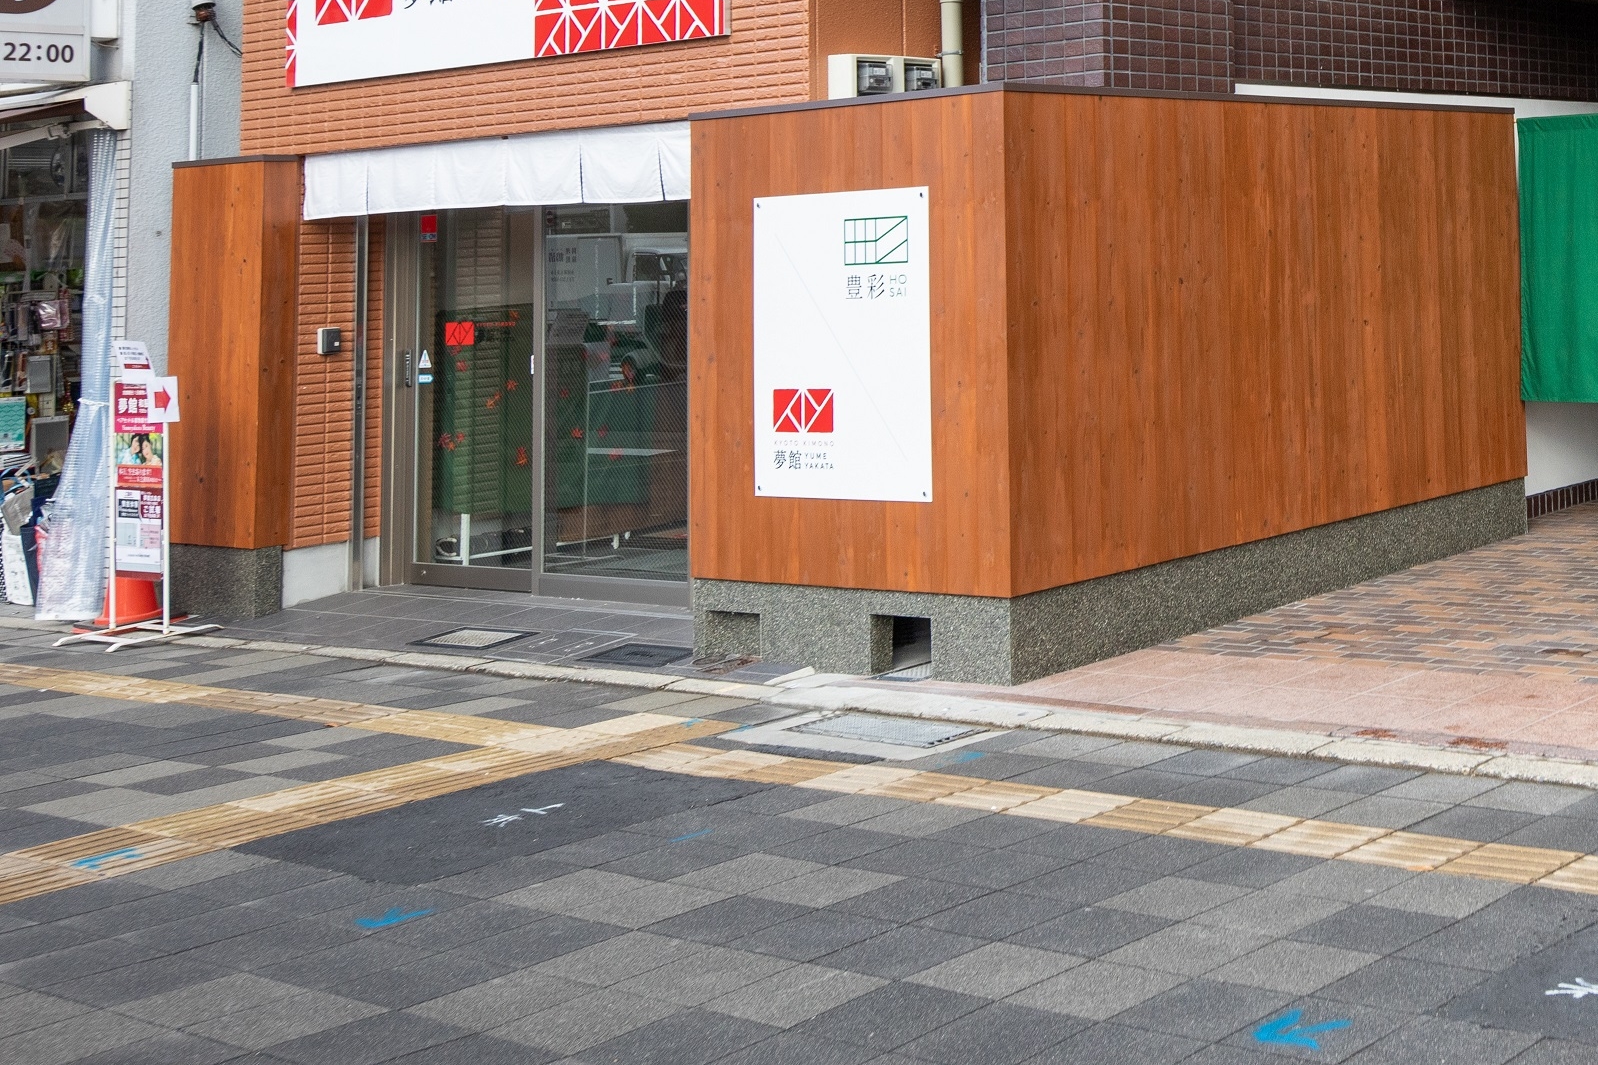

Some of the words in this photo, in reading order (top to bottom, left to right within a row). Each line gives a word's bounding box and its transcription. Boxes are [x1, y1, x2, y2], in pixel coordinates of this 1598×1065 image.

[3, 42, 74, 63] 22:00
[889, 274, 908, 285] HO
[845, 274, 886, 300] 豊彩
[889, 287, 907, 298] SAI
[773, 450, 802, 470] 夢館
[804, 452, 828, 461] YUME
[804, 462, 835, 471] YAKATA
